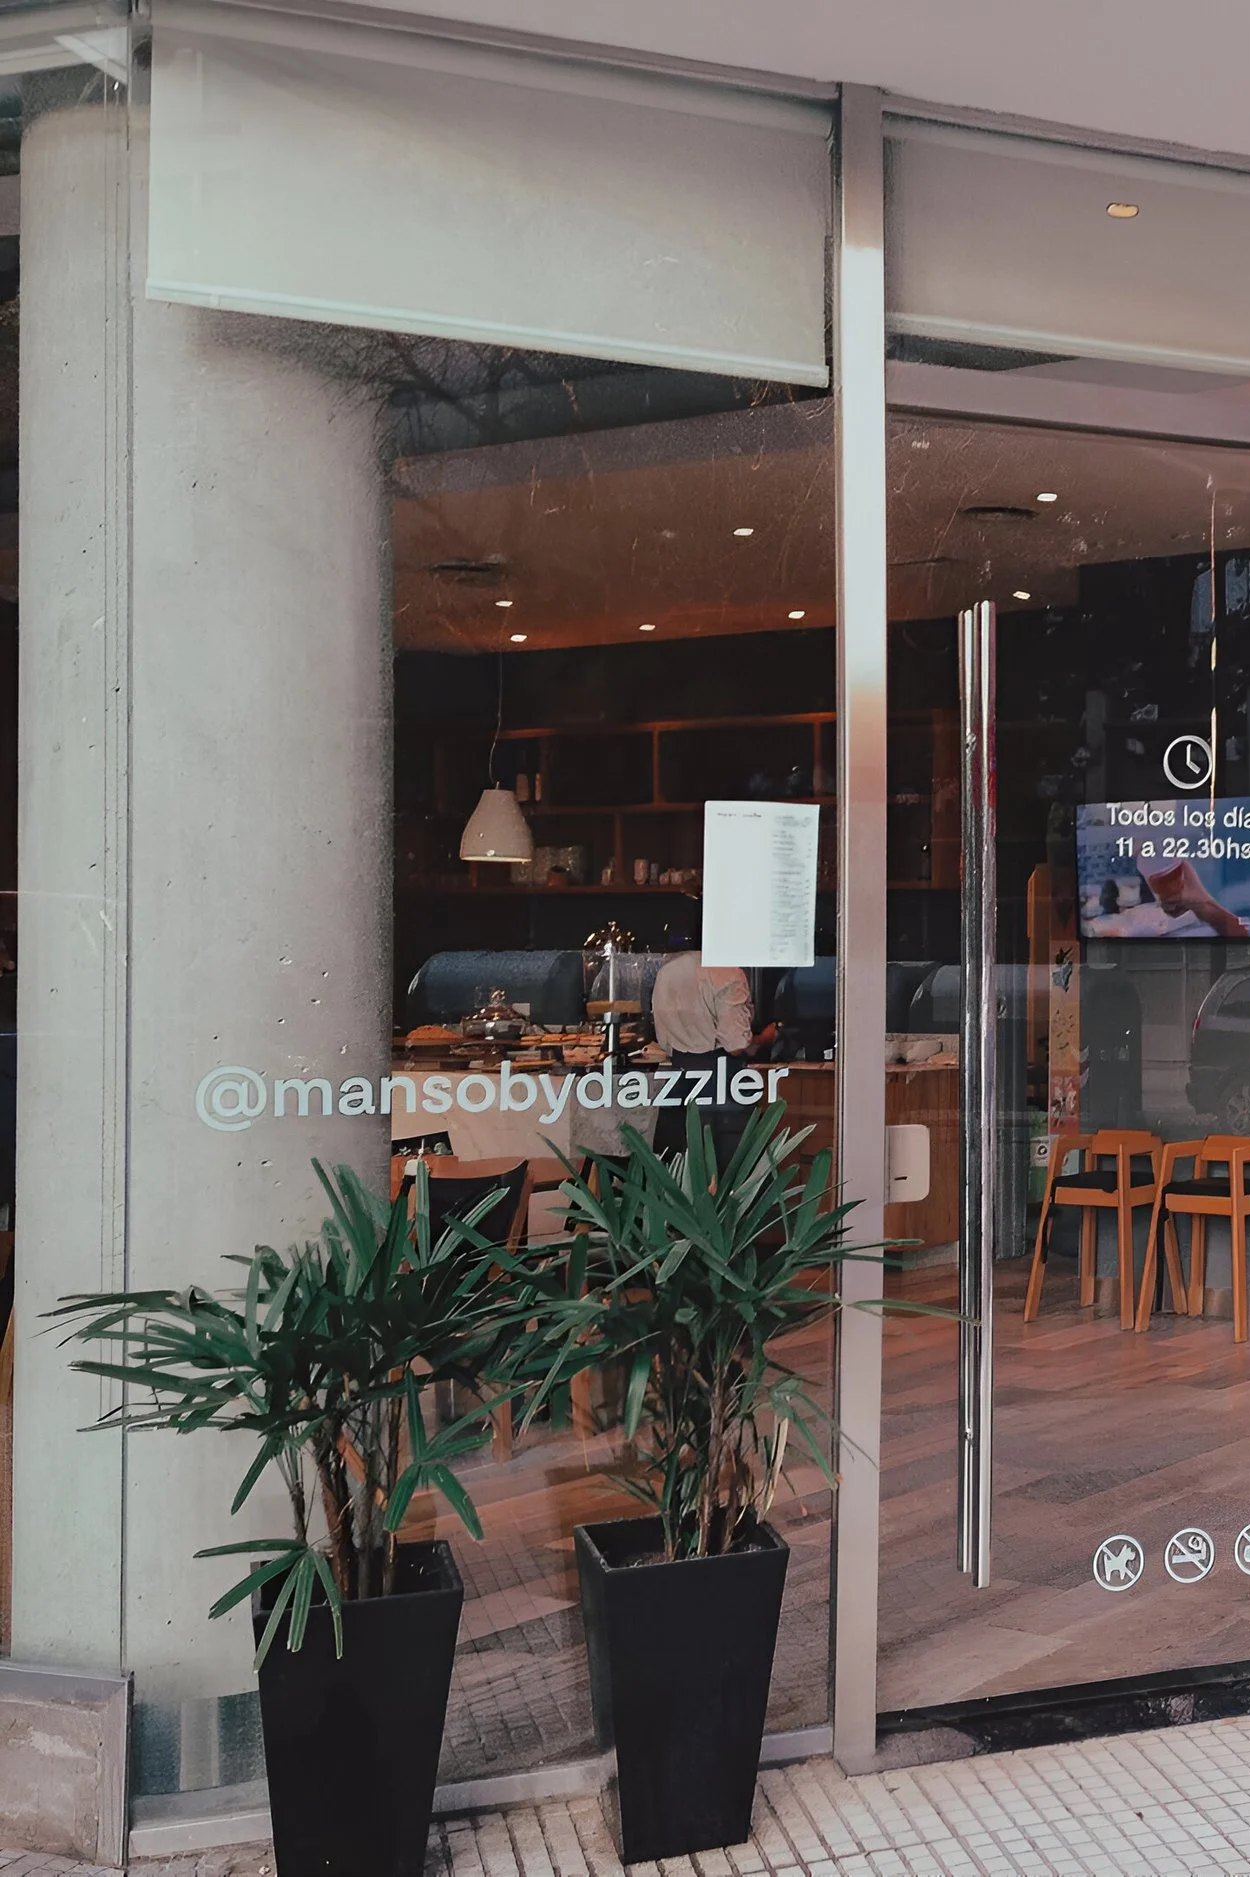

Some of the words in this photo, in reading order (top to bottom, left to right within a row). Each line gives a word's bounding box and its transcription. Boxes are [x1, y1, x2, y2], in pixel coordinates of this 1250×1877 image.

[1106, 802, 1176, 827] Todos
[1183, 805, 1216, 828] los
[1115, 837, 1133, 858] 11
[1141, 841, 1156, 858] a
[193, 1056, 790, 1132] @mansobydazzler
